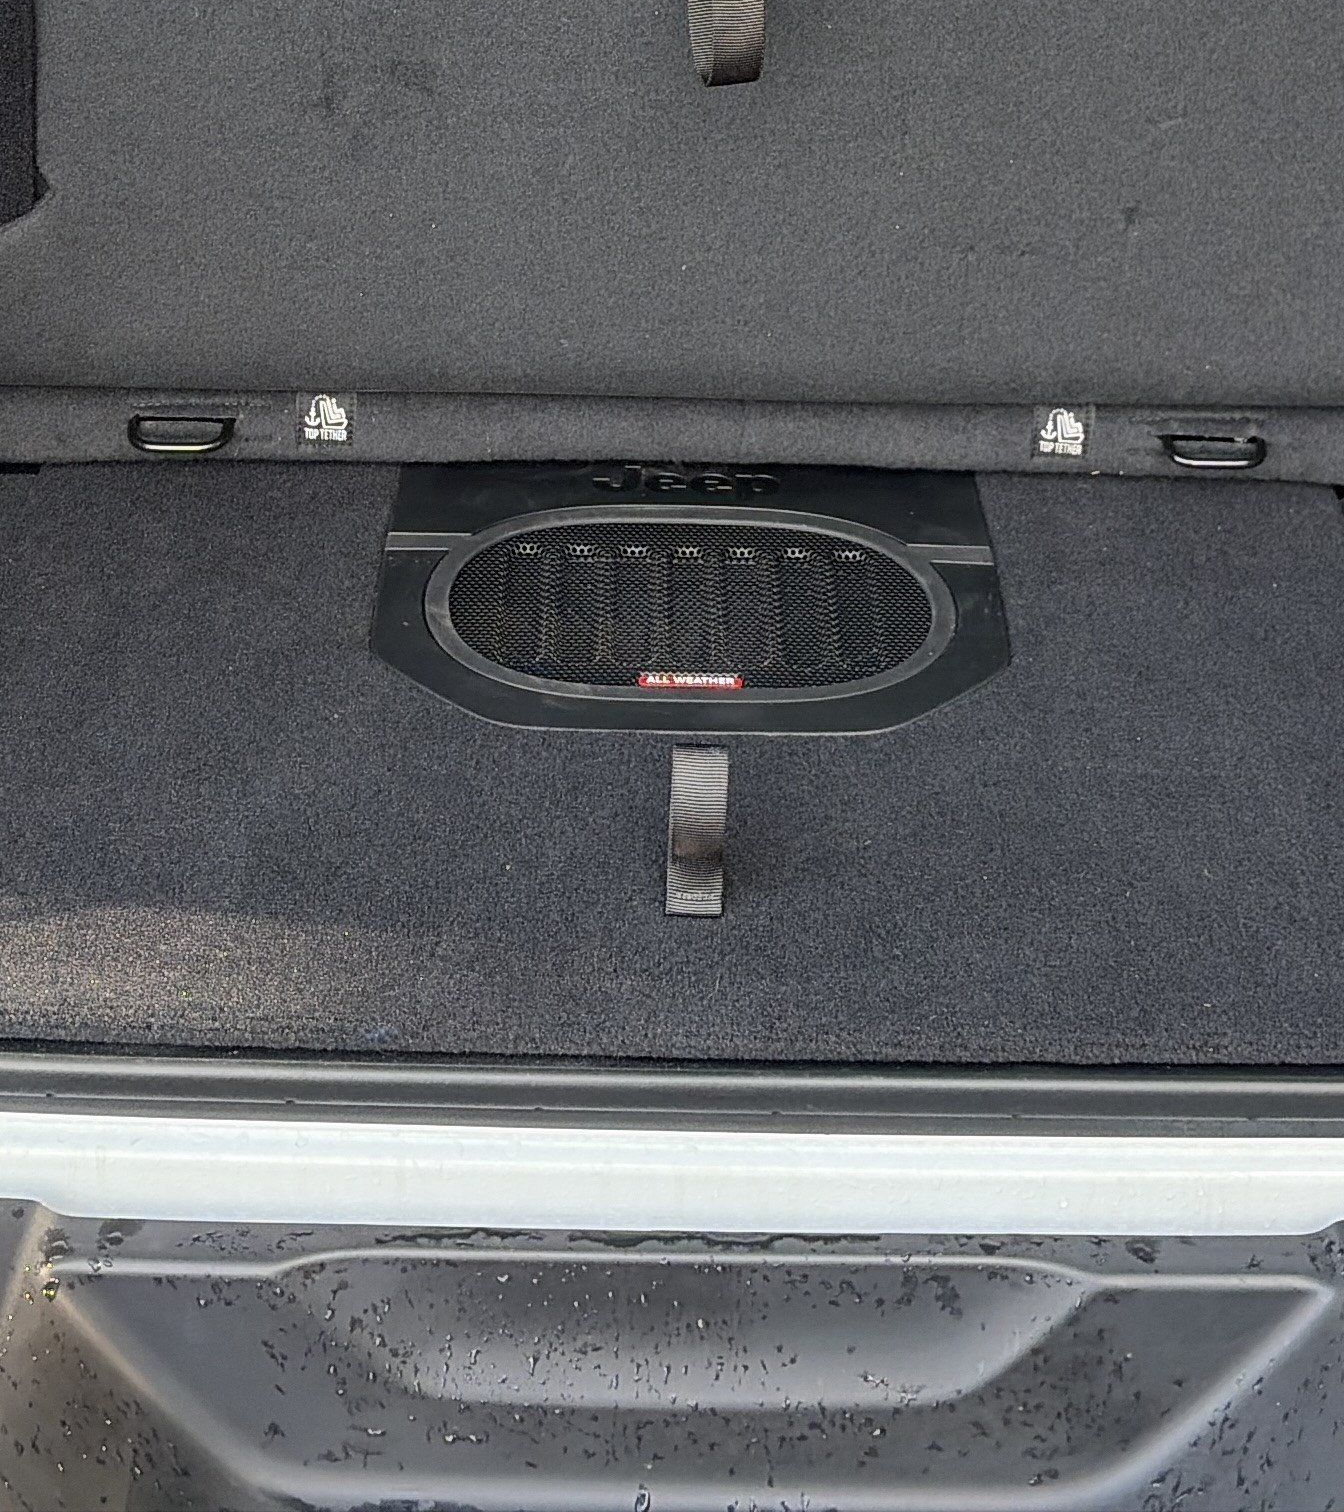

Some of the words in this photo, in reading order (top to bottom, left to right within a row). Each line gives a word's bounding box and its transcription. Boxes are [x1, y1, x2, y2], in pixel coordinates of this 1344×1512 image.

[304, 427, 319, 440] TOP
[319, 428, 348, 442] TETHER
[1038, 440, 1055, 453] TOP
[1055, 442, 1083, 456] TETHER
[592, 465, 780, 499] Jeep
[646, 675, 672, 684] ALL
[674, 675, 736, 686] WEATHER
